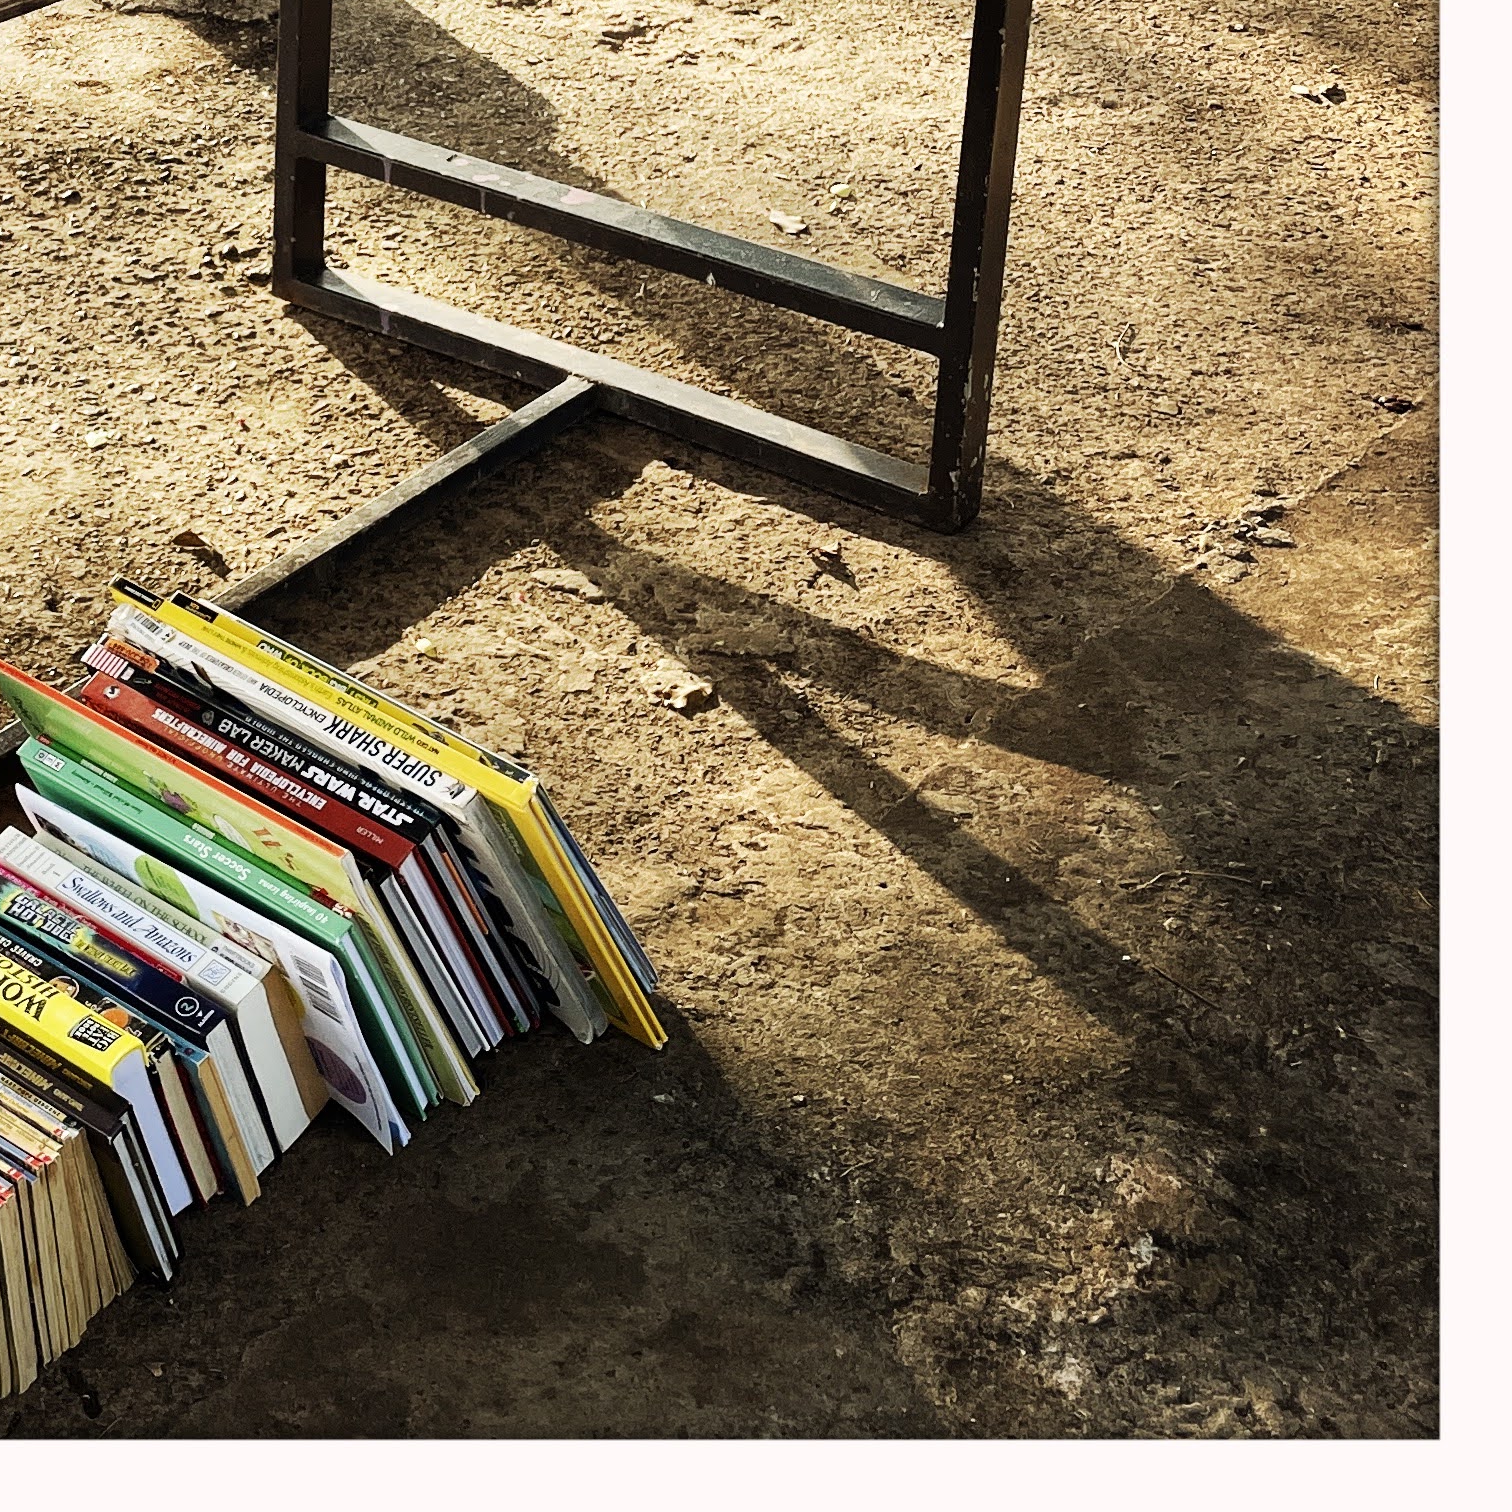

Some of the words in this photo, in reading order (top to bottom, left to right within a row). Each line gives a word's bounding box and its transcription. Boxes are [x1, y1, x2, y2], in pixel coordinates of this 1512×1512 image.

[257, 681, 327, 724] ENCYCLOPEDIA
[335, 696, 362, 715] ATLAS
[150, 706, 228, 753] MINECRAFTERS
[215, 716, 252, 745] LAB
[322, 713, 384, 758] SHARK
[360, 709, 395, 732] ANIMAL
[393, 726, 417, 743] WILD
[225, 746, 251, 769] FOR
[247, 732, 306, 772] MAKER
[376, 743, 442, 789] SUPER
[224, 761, 278, 793] ULTIMATE
[248, 760, 328, 810] ENCYCLOPEDIA
[299, 761, 358, 801] WARS
[352, 789, 414, 831] STAR
[180, 832, 213, 859] Stars
[354, 824, 385, 845] MILLER
[208, 849, 252, 881] Soccer
[256, 876, 281, 895] icons
[61, 870, 119, 916] Swallows
[110, 901, 141, 929] and
[132, 916, 200, 967] Amazons
[80, 863, 102, 880] THE
[133, 895, 151, 910] ON
[148, 904, 170, 922] THE
[167, 915, 208, 945] SCHOOL
[278, 888, 318, 917] inspiring
[313, 910, 330, 925] 40
[3, 897, 42, 930] HOT
[37, 914, 77, 948] DOGS
[0, 1027, 62, 1072] MINECRAFT
[97, 1031, 120, 1050] BIG
